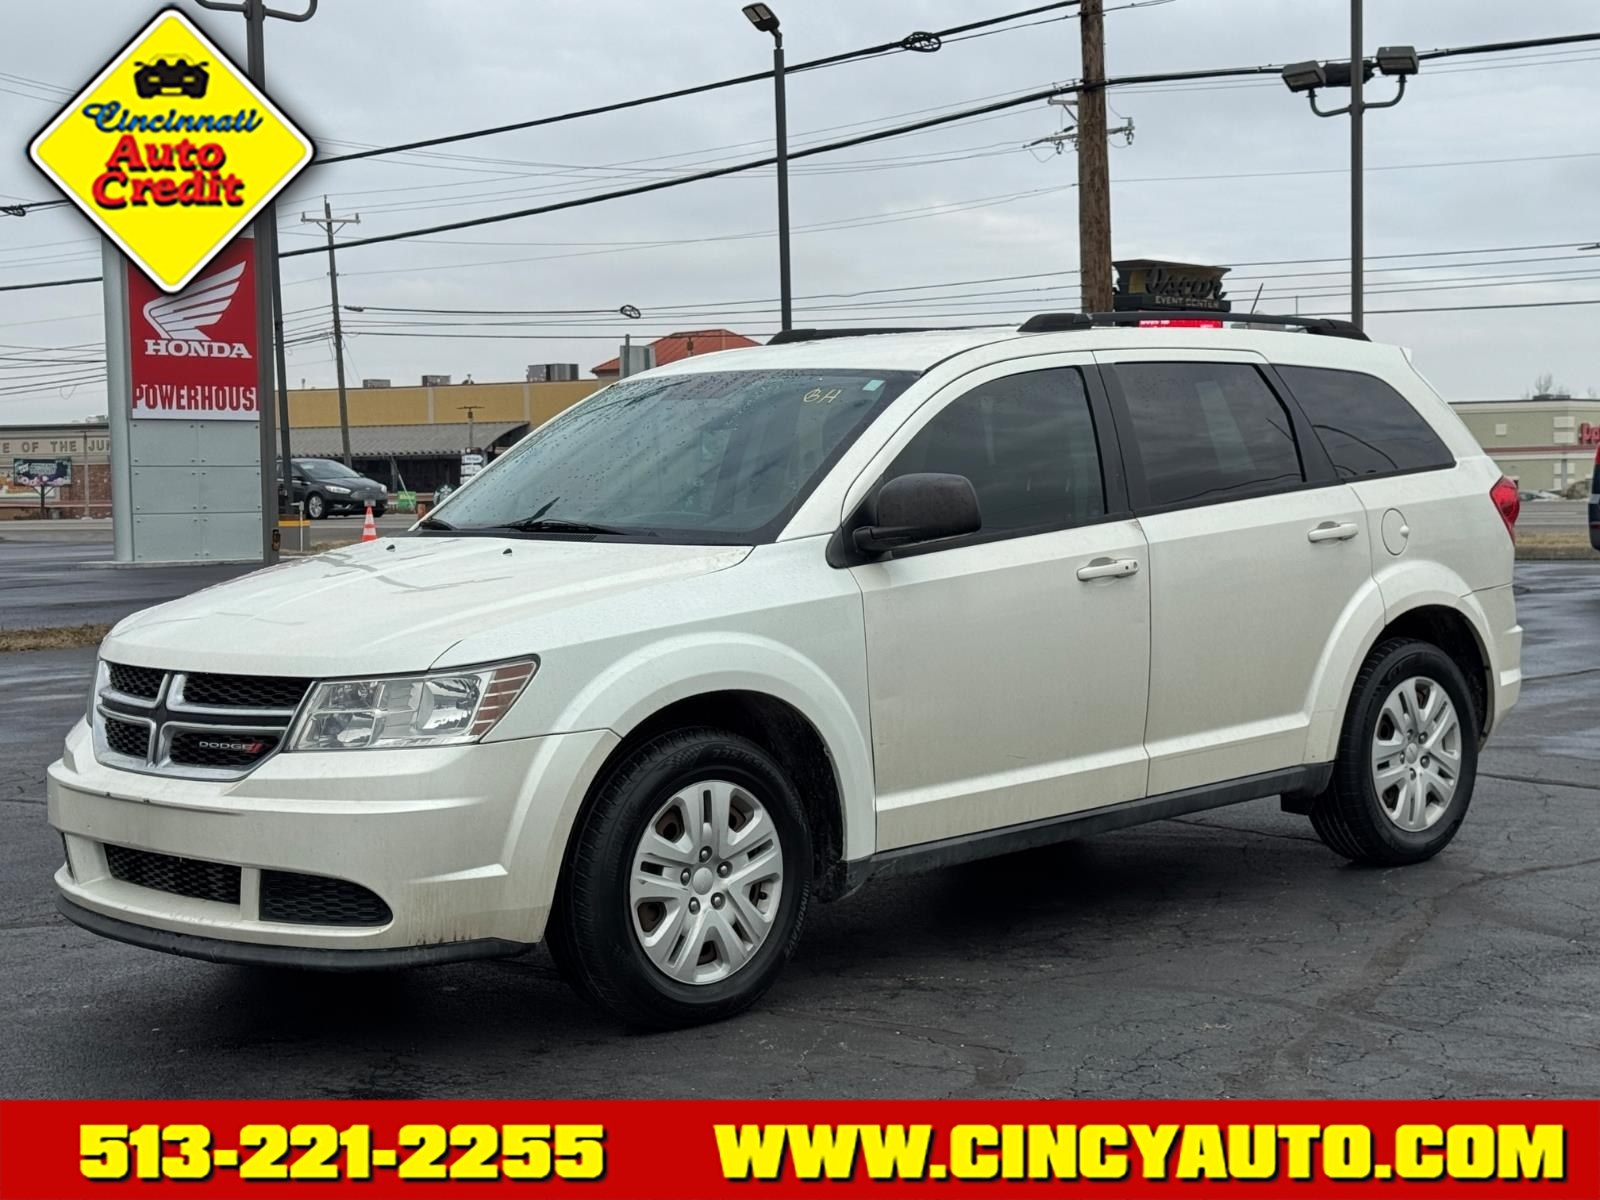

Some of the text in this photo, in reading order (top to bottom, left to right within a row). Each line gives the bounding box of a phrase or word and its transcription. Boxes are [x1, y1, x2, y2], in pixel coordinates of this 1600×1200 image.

[1155, 295, 1220, 309] EVENT CENTER
[144, 339, 253, 359] HONDA
[22, 441, 39, 453] OF
[50, 440, 77, 453] THE
[199, 741, 252, 751] DODGE
